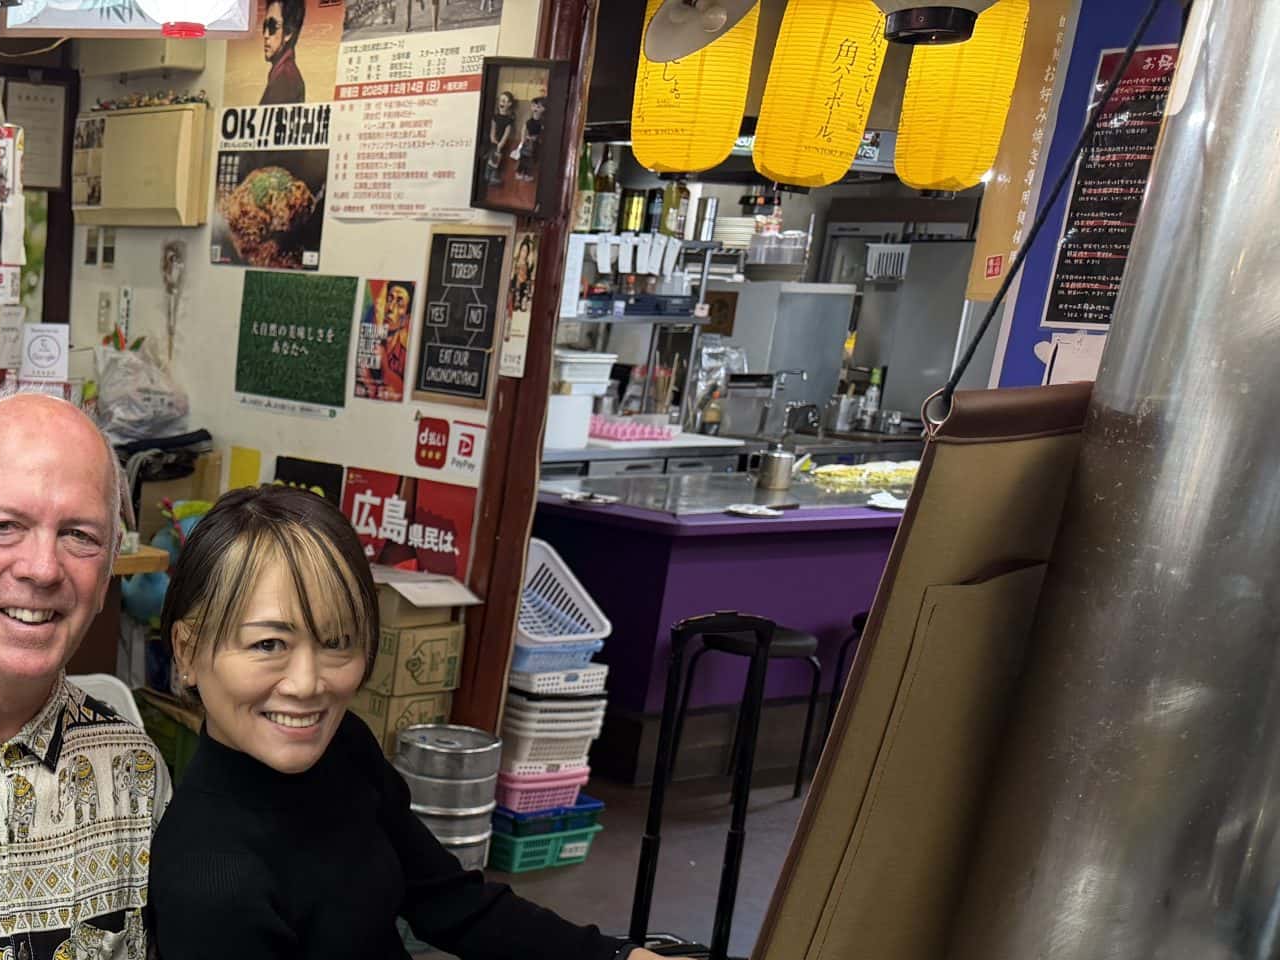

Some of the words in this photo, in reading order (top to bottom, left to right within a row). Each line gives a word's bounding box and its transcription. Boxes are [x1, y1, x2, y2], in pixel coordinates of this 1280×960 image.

[450, 243, 483, 259] FEELING
[451, 262, 478, 279] TIRED?
[431, 308, 445, 322] YES
[470, 309, 482, 325] NO
[252, 321, 335, 343] 大自然の美味しさを
[272, 340, 309, 356] あなたへ
[438, 349, 452, 363] EAT
[454, 351, 469, 366] OUR
[425, 366, 479, 387] OKONOMIYAKI
[419, 427, 447, 447] d払い
[450, 458, 476, 471] PayPay
